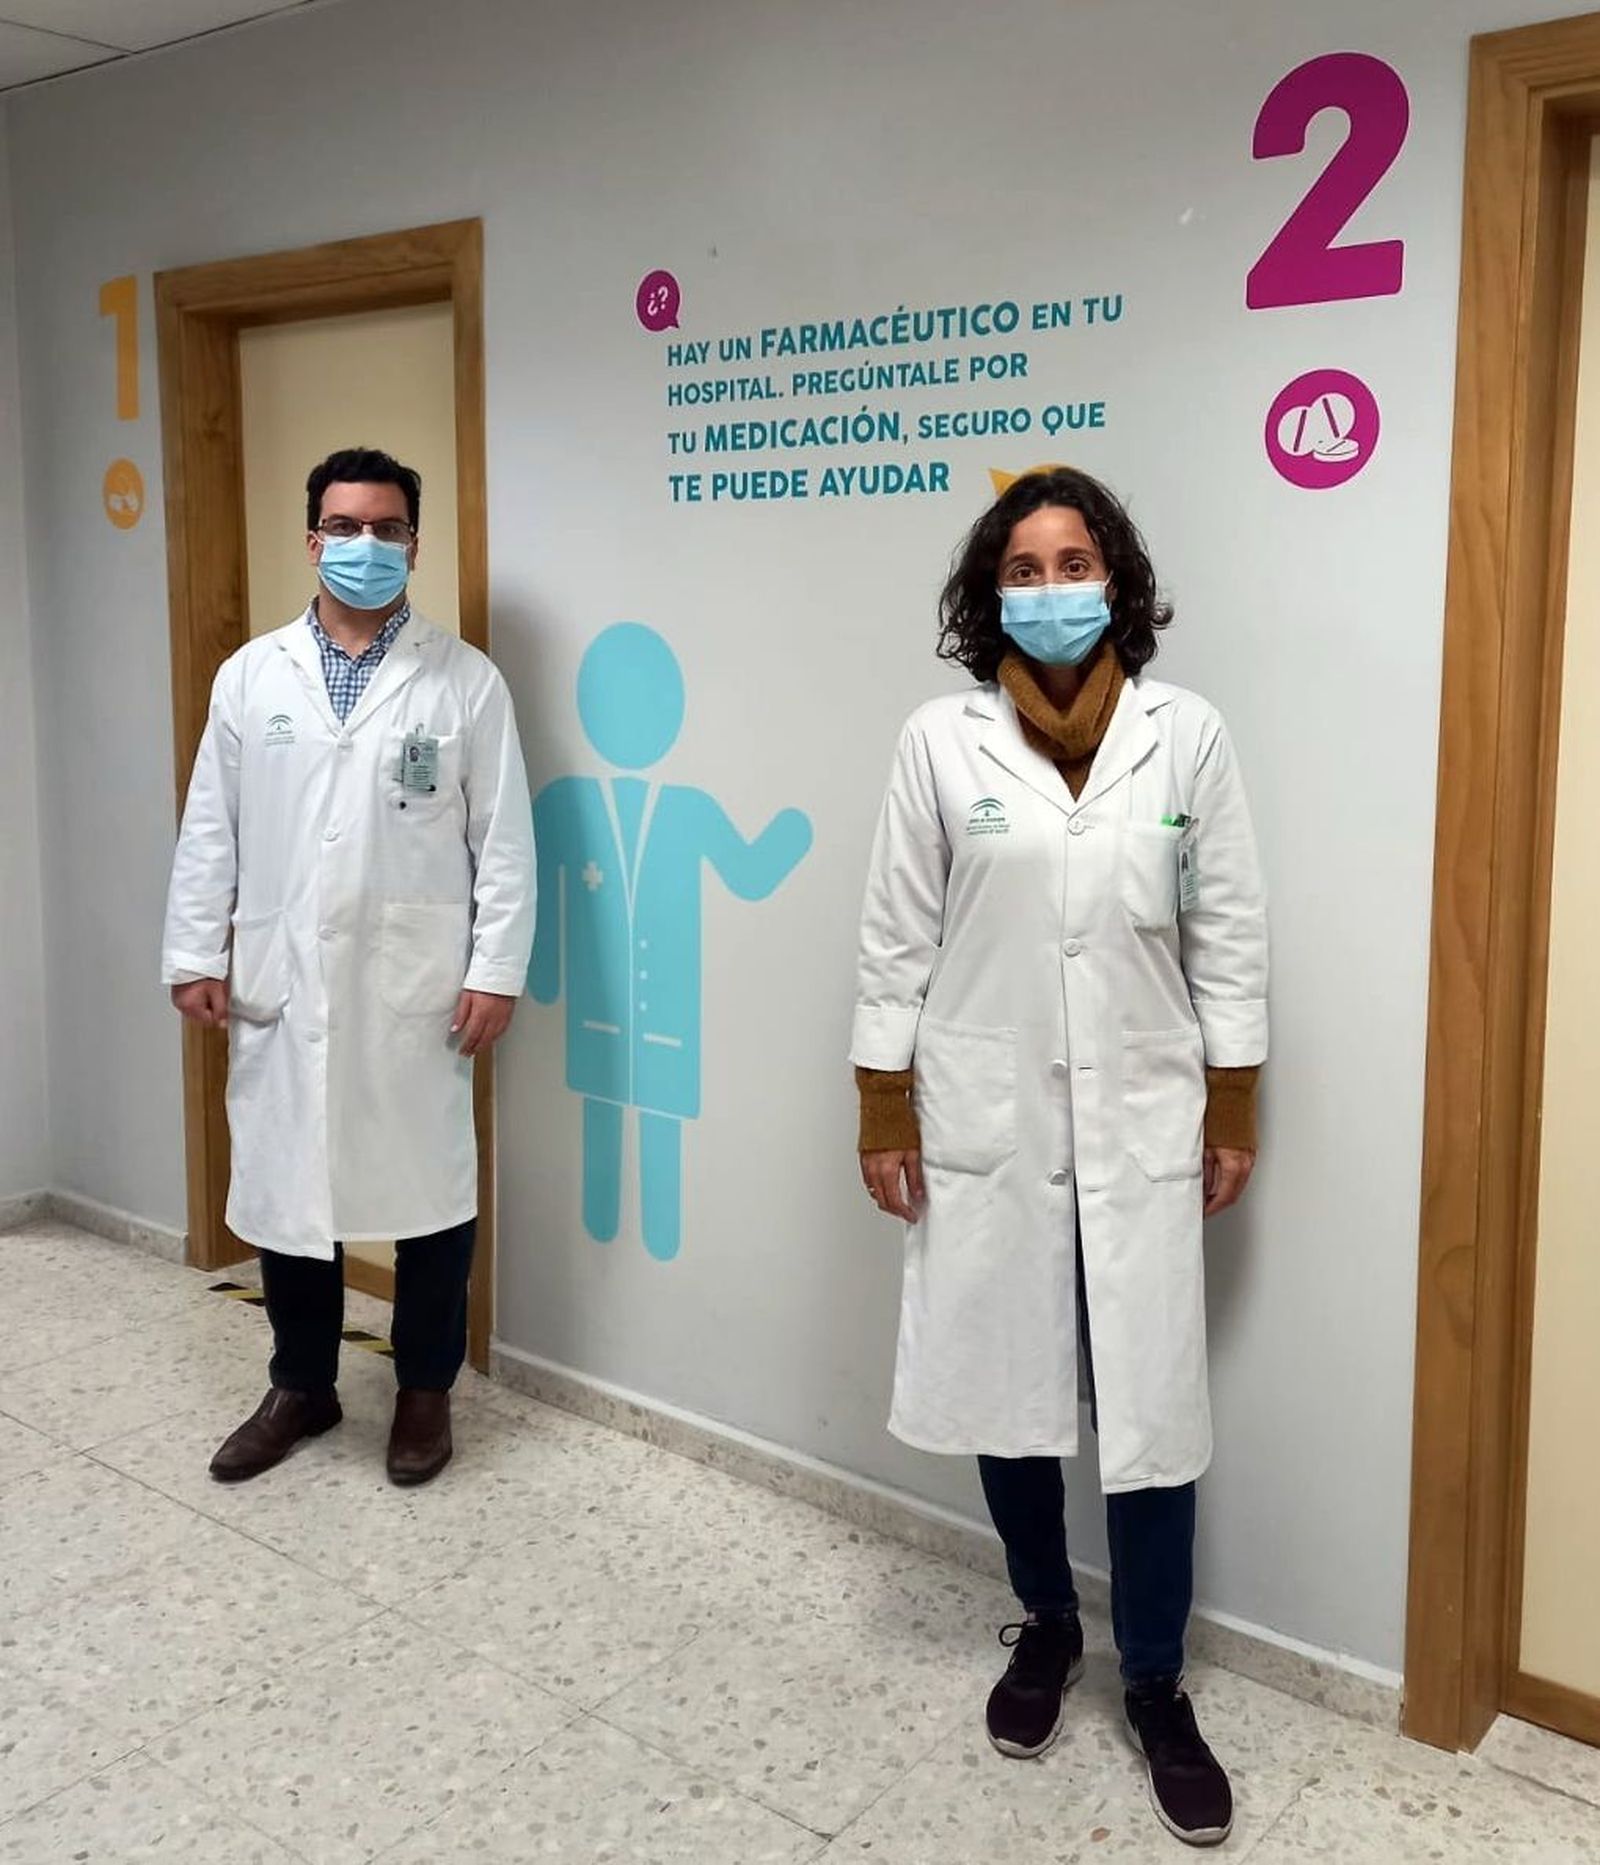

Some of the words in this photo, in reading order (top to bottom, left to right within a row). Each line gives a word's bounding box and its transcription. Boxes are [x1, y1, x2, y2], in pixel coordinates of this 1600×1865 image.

[1246, 52, 1409, 310] 2
[99, 275, 139, 421] 1
[667, 342, 709, 367] HAY
[719, 337, 752, 361] UN
[760, 302, 1020, 358] FARMACÉUTICO
[1032, 301, 1072, 330] EN
[1083, 294, 1124, 325] TU
[667, 378, 784, 406] HOSPITAL.
[792, 359, 960, 397] PREGÚNTALE
[970, 352, 1028, 382] POR
[668, 432, 697, 454] TU
[704, 405, 909, 452] MEDICACIÓN,
[918, 407, 1032, 440] SEGURO
[1041, 402, 1106, 437] QUE
[669, 473, 701, 502] TE
[712, 469, 809, 501] PUEDE
[819, 461, 950, 498] AYUDAR
